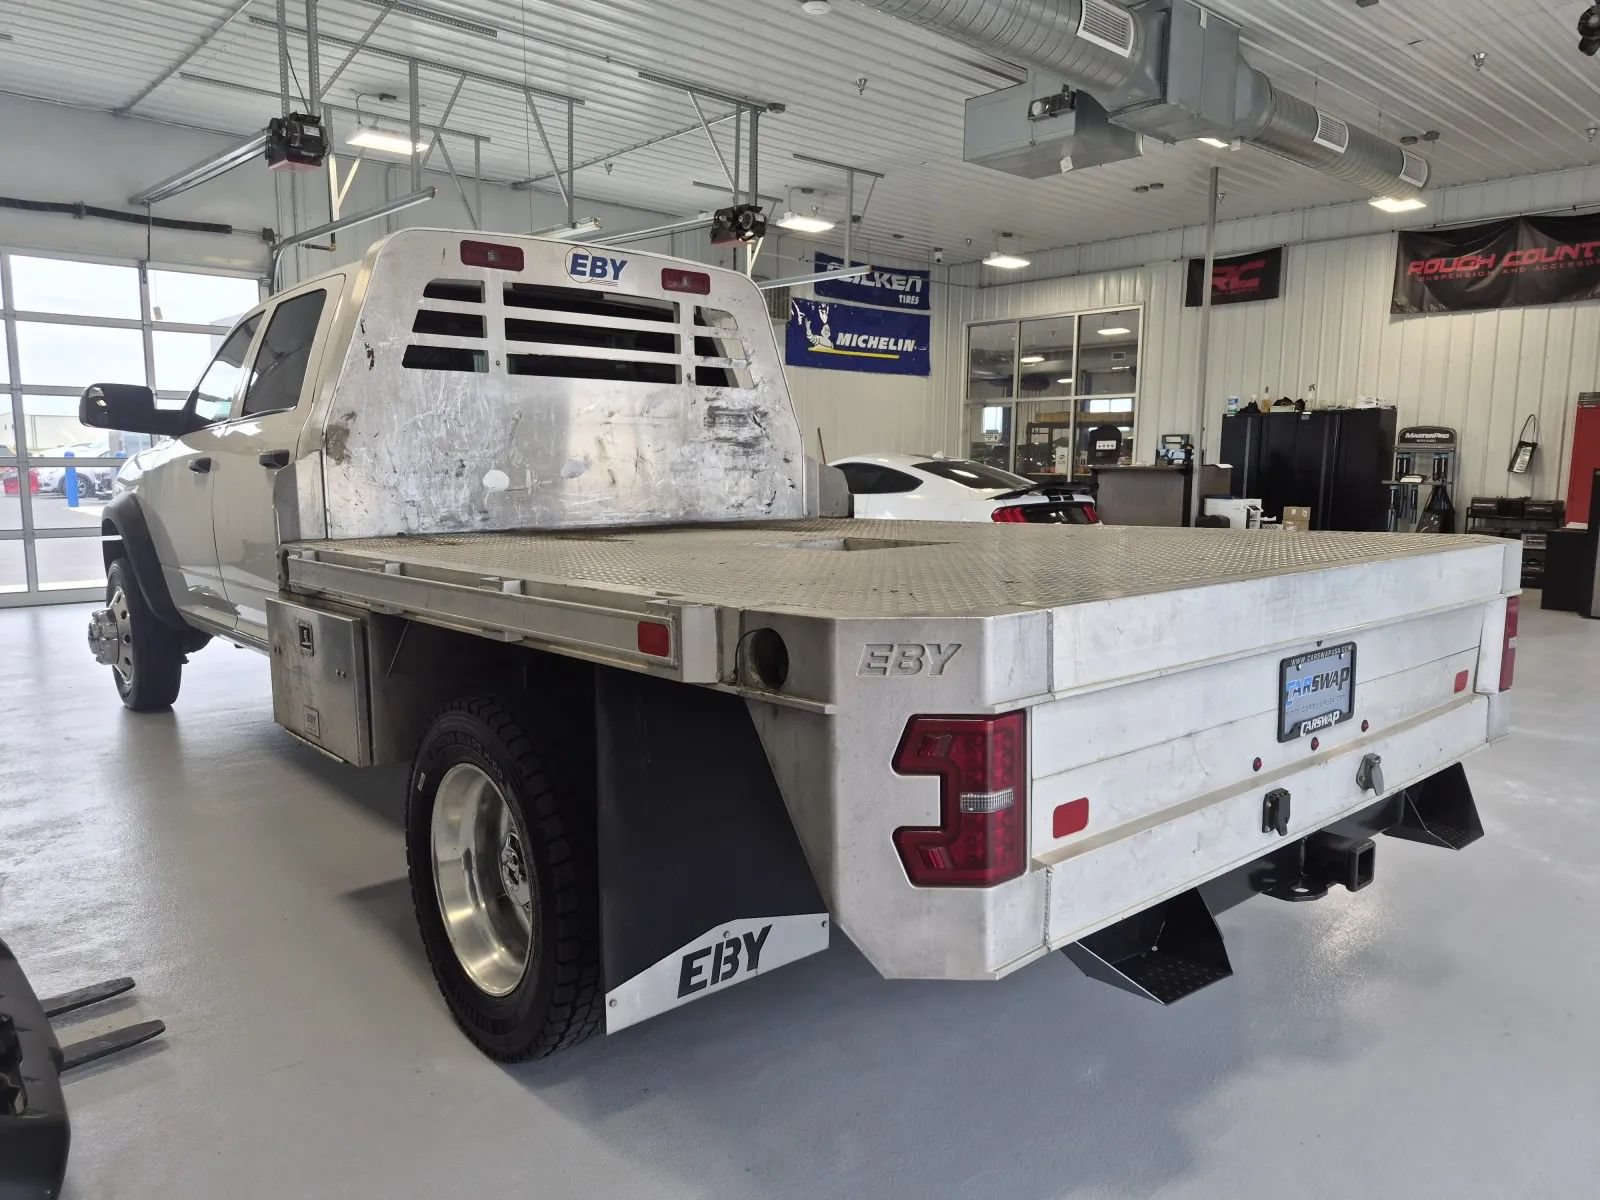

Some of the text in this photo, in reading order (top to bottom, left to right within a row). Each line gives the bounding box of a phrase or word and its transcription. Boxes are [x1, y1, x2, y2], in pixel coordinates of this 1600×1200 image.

[570, 253, 628, 280] EBY
[1407, 253, 1496, 275] ROUGH
[1417, 271, 1496, 281] SUSPENSION
[1502, 266, 1526, 274] AND
[898, 294, 919, 304] TIRES
[836, 332, 915, 352] MICHELIN
[856, 643, 962, 676] EBY
[1284, 666, 1351, 707] CARSWAP
[1300, 710, 1341, 737] CARSWAP
[677, 924, 773, 999] EBY
